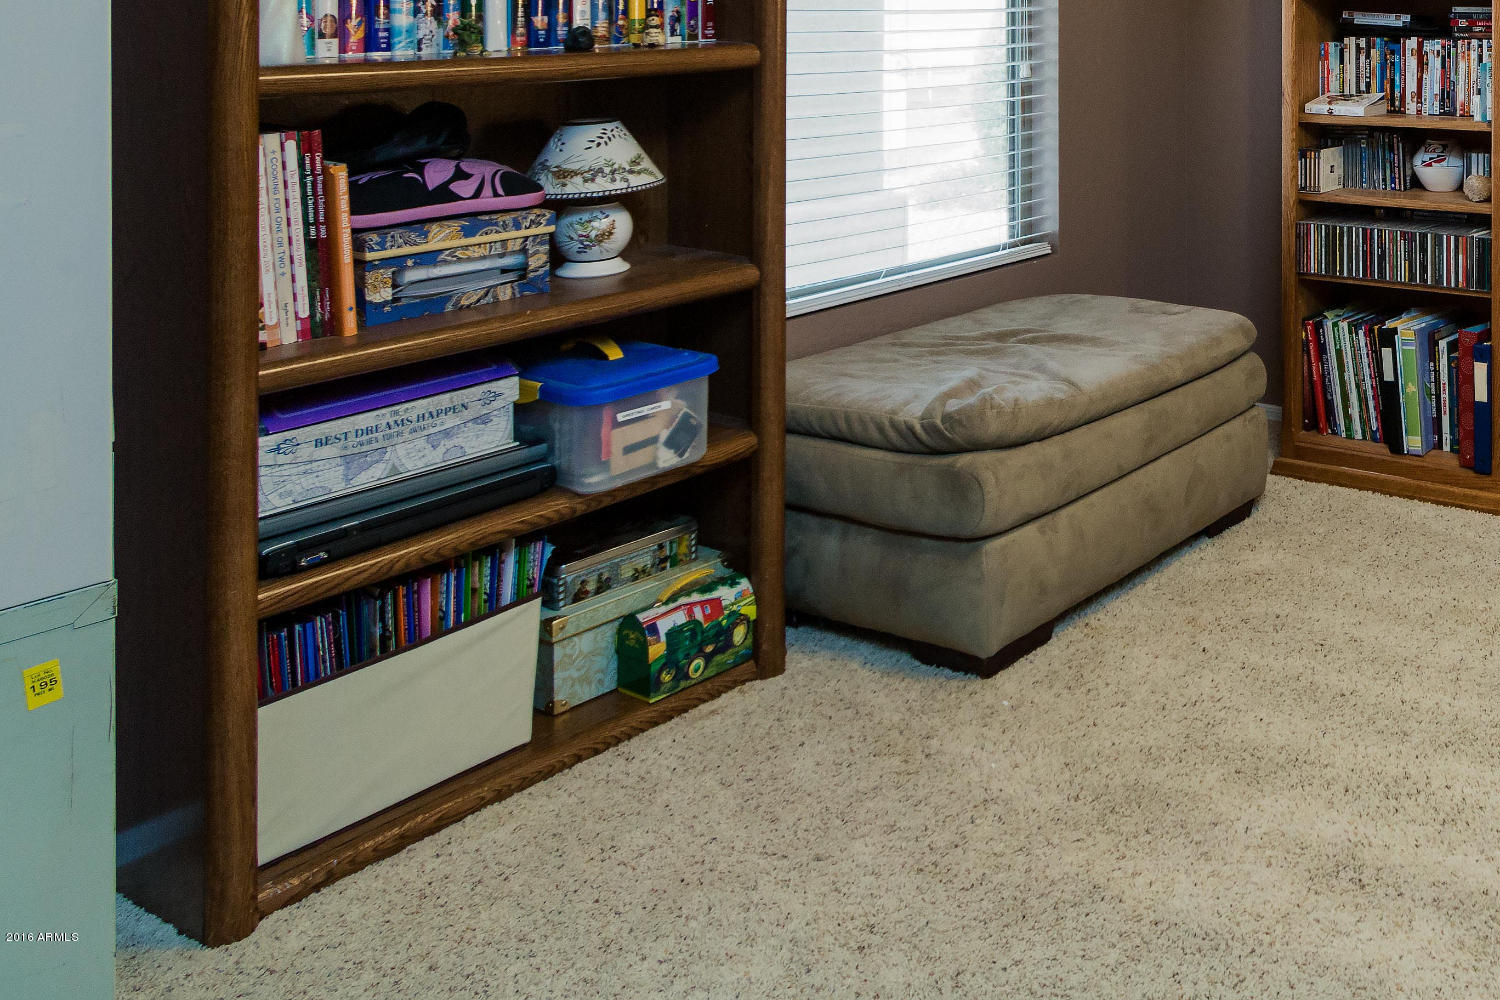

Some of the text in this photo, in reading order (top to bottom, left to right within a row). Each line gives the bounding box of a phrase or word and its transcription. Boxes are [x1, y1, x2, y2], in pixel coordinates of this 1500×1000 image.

[303, 153, 312, 176] Country
[314, 153, 323, 176] Country
[304, 175, 313, 196] Woman
[316, 175, 324, 196] Woman
[270, 157, 286, 269] COOKING FOR ONE OR TWO
[306, 196, 315, 223] Christmas
[317, 196, 326, 223] Christmas
[313, 401, 469, 449] BEST DREAMS HAPPEN
[30, 676, 58, 694] 195
